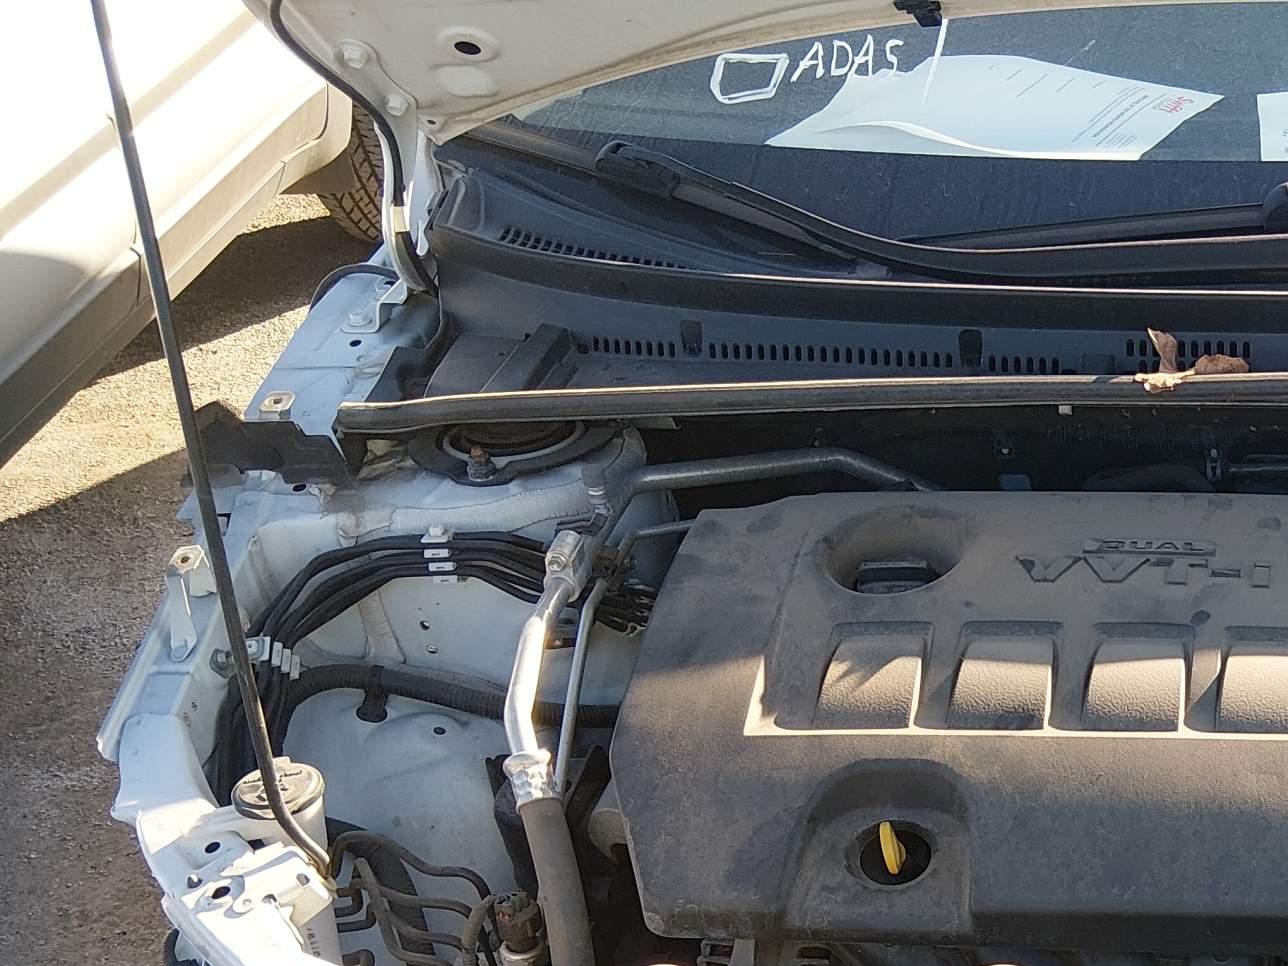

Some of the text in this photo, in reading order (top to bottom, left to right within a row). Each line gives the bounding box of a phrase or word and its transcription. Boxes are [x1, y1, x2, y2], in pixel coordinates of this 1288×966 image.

[790, 34, 904, 82] ADAS
[1160, 96, 1195, 114] Swift
[1100, 539, 1206, 552] DUAL
